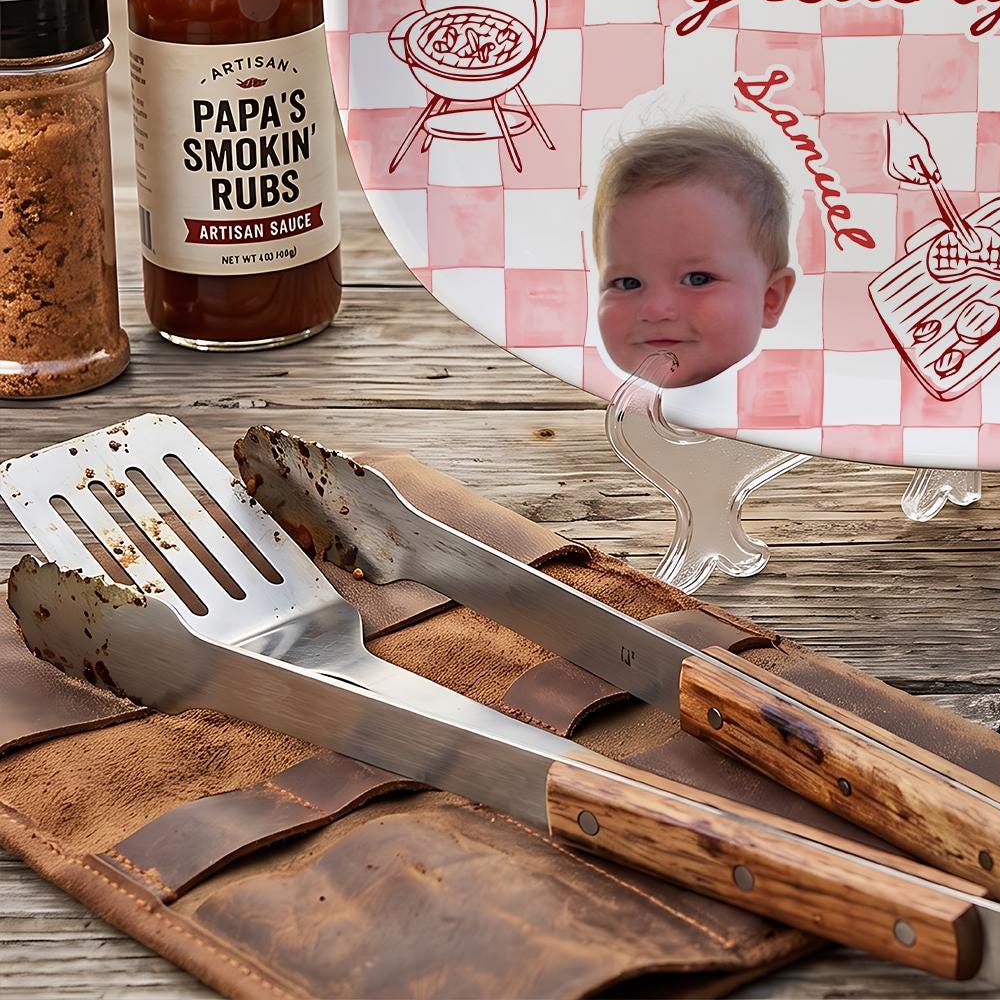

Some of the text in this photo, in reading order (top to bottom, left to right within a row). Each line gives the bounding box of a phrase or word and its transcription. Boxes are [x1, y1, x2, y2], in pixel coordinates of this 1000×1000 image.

[211, 56, 289, 80] ARTISAN
[193, 89, 306, 133] PAPA'S
[183, 123, 316, 172] SMOKIN'
[734, 69, 877, 252] Samuel
[211, 170, 300, 211] RUBS
[199, 212, 312, 240] ARTISAN SAUCE
[221, 255, 240, 264] NET
[242, 254, 257, 263] WT
